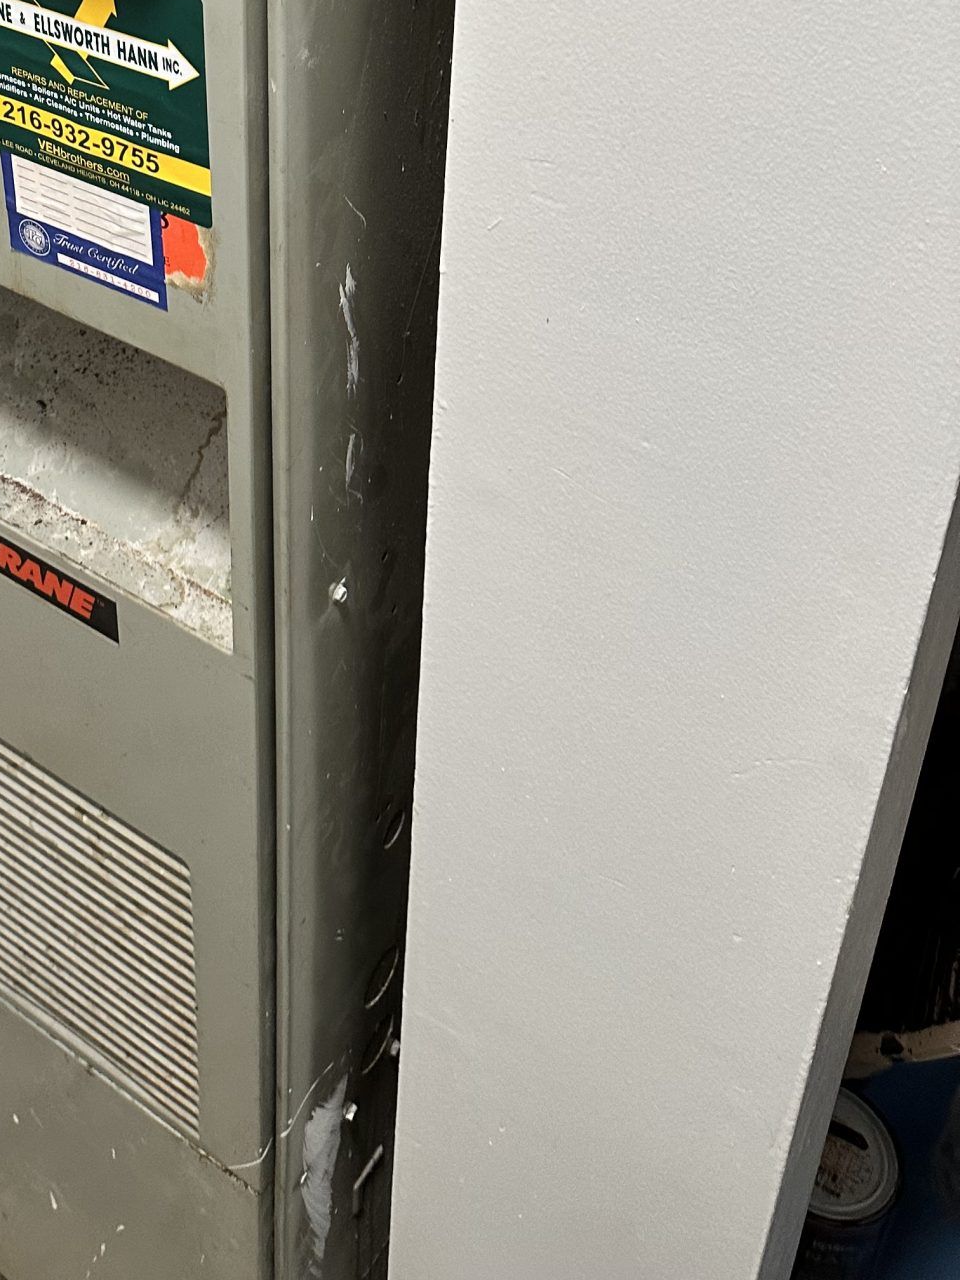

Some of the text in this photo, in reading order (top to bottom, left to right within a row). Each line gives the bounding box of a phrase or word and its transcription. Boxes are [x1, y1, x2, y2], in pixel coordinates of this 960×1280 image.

[19, 12, 26, 25] &
[33, 13, 111, 57] ELLSWORTH
[117, 39, 159, 71] HANN
[162, 56, 184, 76] INC.
[11, 66, 148, 121] REPAIRS AND REPLACEMENT OF
[31, 83, 59, 99] Boilers
[64, 96, 77, 107] A/C
[79, 100, 100, 114] Units
[106, 110, 121, 122] Hot
[122, 114, 146, 130] Water
[148, 123, 172, 139] Tanks
[2, 100, 160, 173] 216-932-9755
[34, 93, 45, 104] Air
[45, 98, 78, 117] Cleaners
[84, 111, 134, 136] Thermostats
[141, 131, 180, 154] Plumbing
[1, 138, 14, 149] LEE
[14, 143, 33, 156] ROAD
[37, 153, 76, 173] CLEVELAND
[109, 179, 121, 190] OH
[121, 183, 140, 197] 44118
[145, 194, 157, 203] OH
[157, 198, 169, 208] LIC
[37, 137, 130, 182] VEHbrothers.com
[52, 233, 85, 255] Trust
[87, 246, 139, 275] Certified
